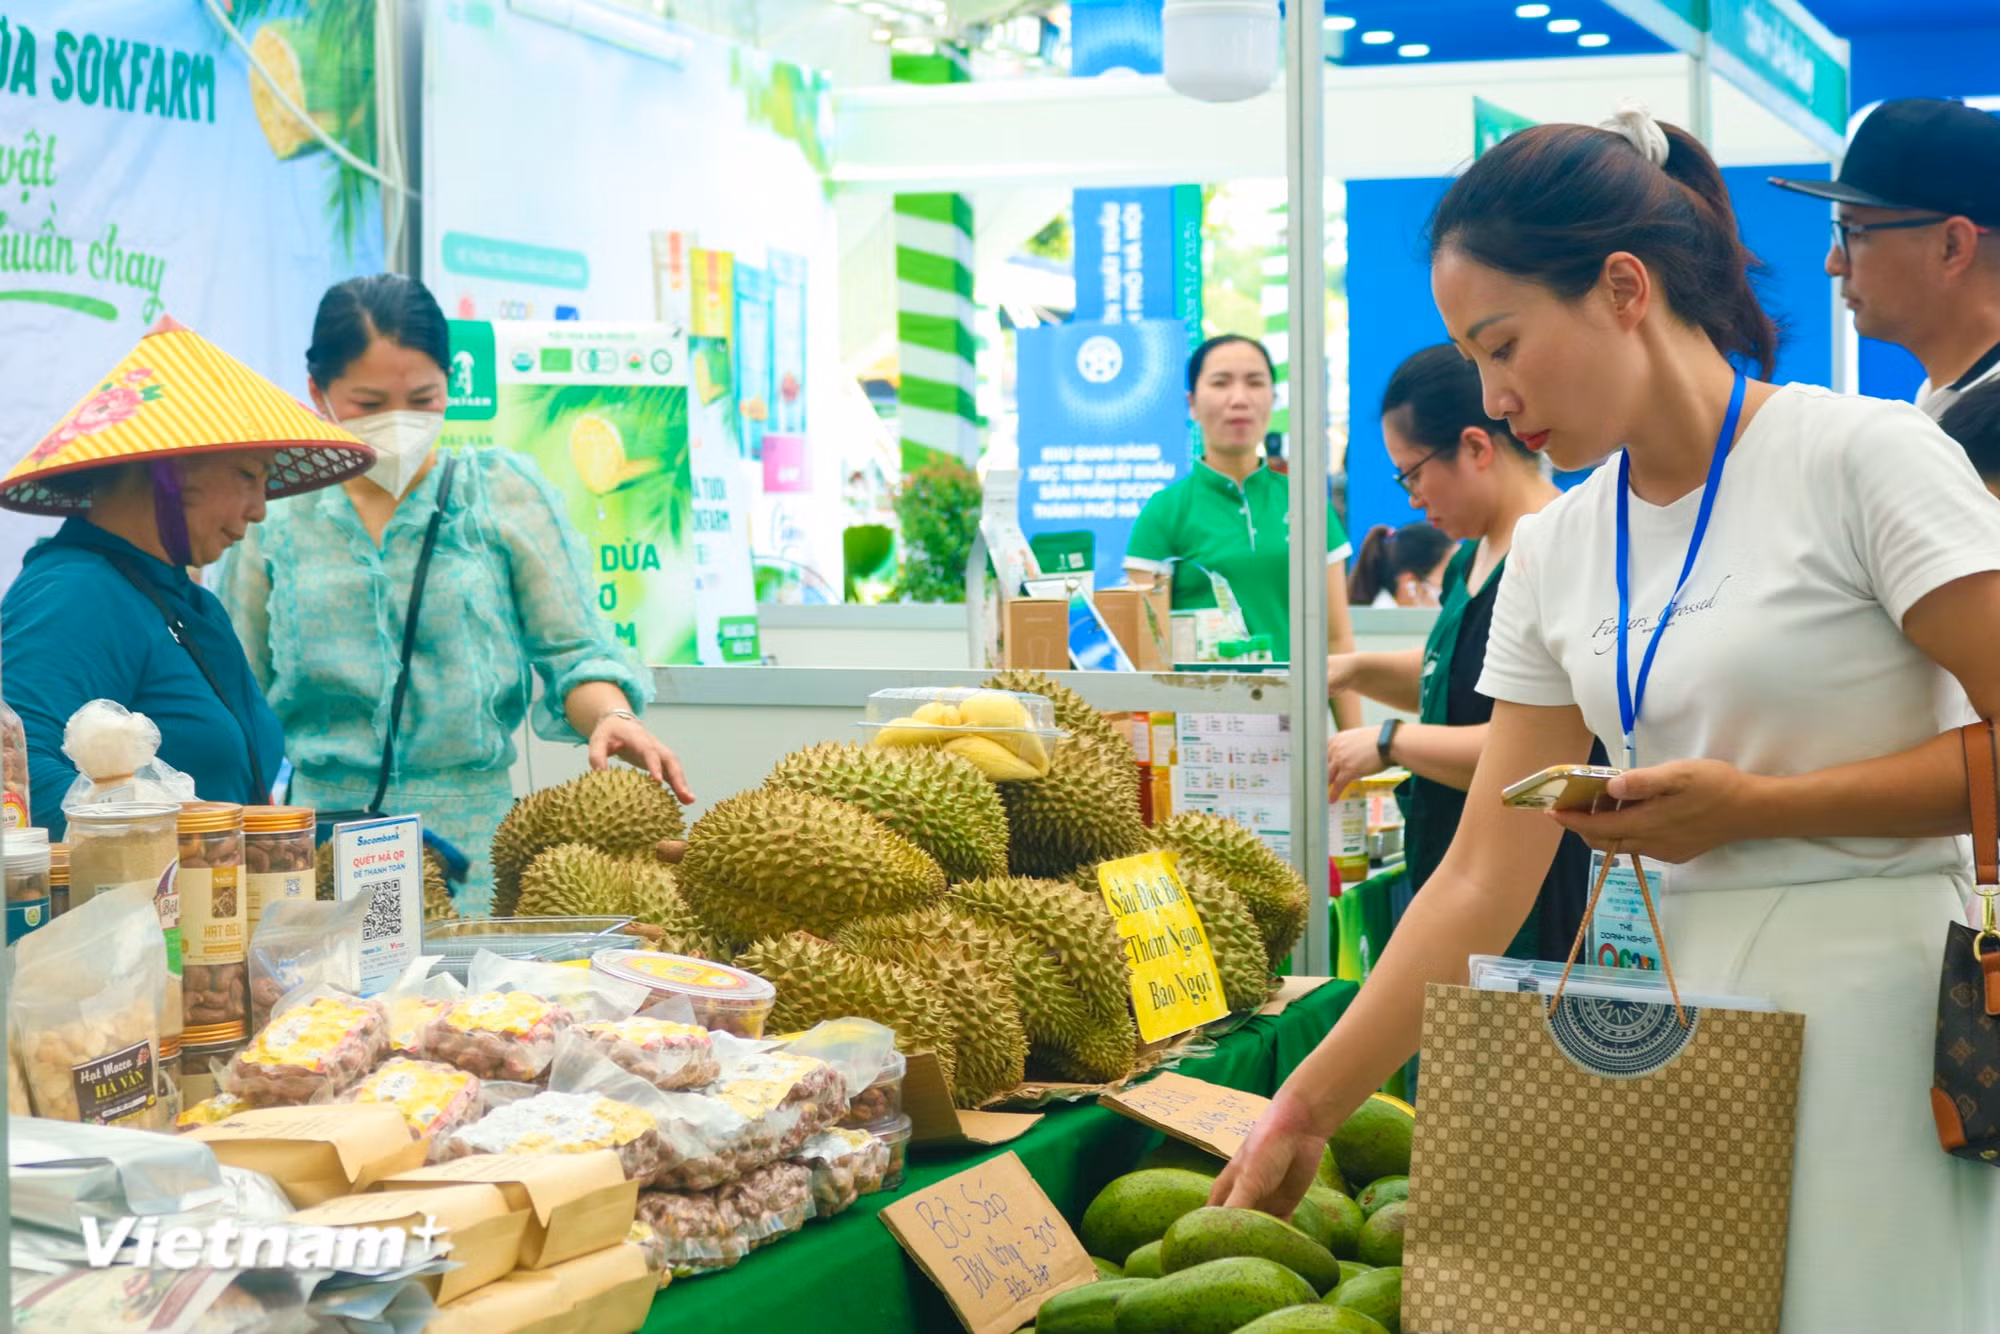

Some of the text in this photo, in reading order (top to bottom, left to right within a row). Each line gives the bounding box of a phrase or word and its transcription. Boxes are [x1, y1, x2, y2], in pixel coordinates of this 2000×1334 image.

[52, 29, 215, 123] SOKFARM
[88, 223, 165, 324] chay
[601, 537, 660, 572] DỪA
[599, 580, 617, 611] Ơ
[1592, 616, 1649, 655] Finers
[358, 832, 399, 846] Sacombank
[353, 853, 376, 868] QUÉT
[393, 849, 406, 861] QR
[364, 866, 388, 878] THANH
[1148, 980, 1177, 1010] Bao
[80, 1067, 102, 1084] Hạt
[95, 1078, 118, 1099] HÀ
